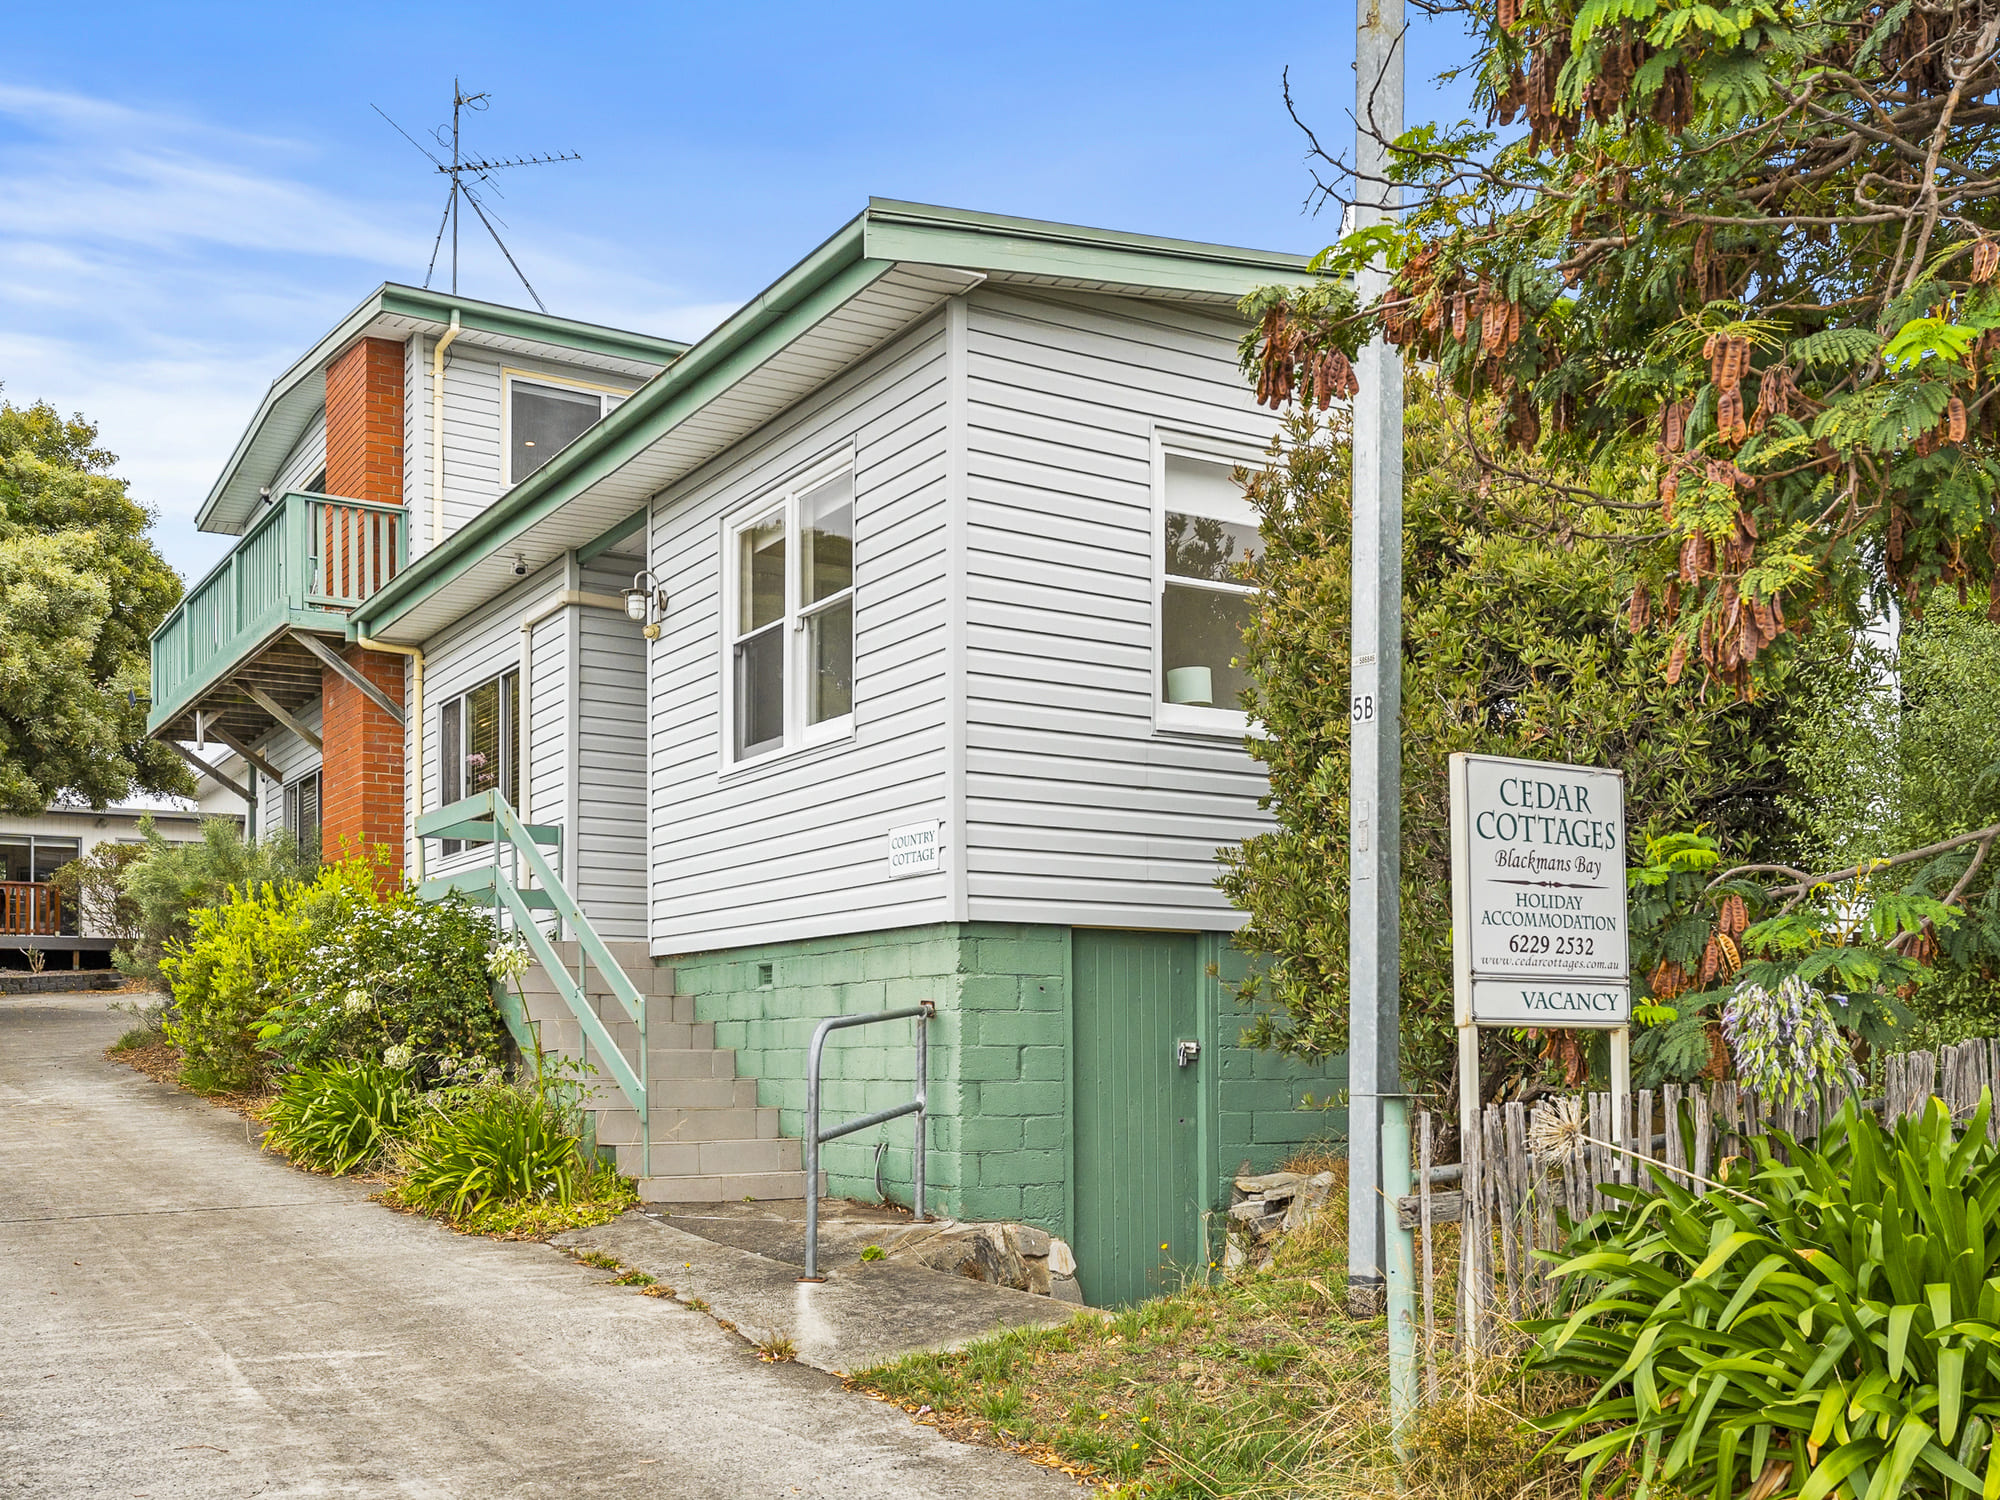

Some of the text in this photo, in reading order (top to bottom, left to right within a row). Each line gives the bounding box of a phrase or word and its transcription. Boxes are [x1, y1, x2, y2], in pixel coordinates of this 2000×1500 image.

[1353, 695, 1373, 721] 5B
[1499, 777, 1592, 814] CEDAR
[891, 829, 935, 850] COUNTRY
[1476, 810, 1616, 851] COTTAGES
[892, 848, 935, 867] COTTAGE
[1494, 848, 1602, 880] Blackmans Bay
[1516, 892, 1583, 911] HOLIDAY
[1481, 910, 1617, 931] ACCOMMODATION
[1509, 934, 1594, 956] 6229 2532
[1481, 955, 1620, 972] www.cedarcottages.com.au
[1521, 991, 1619, 1011] VACANCY
